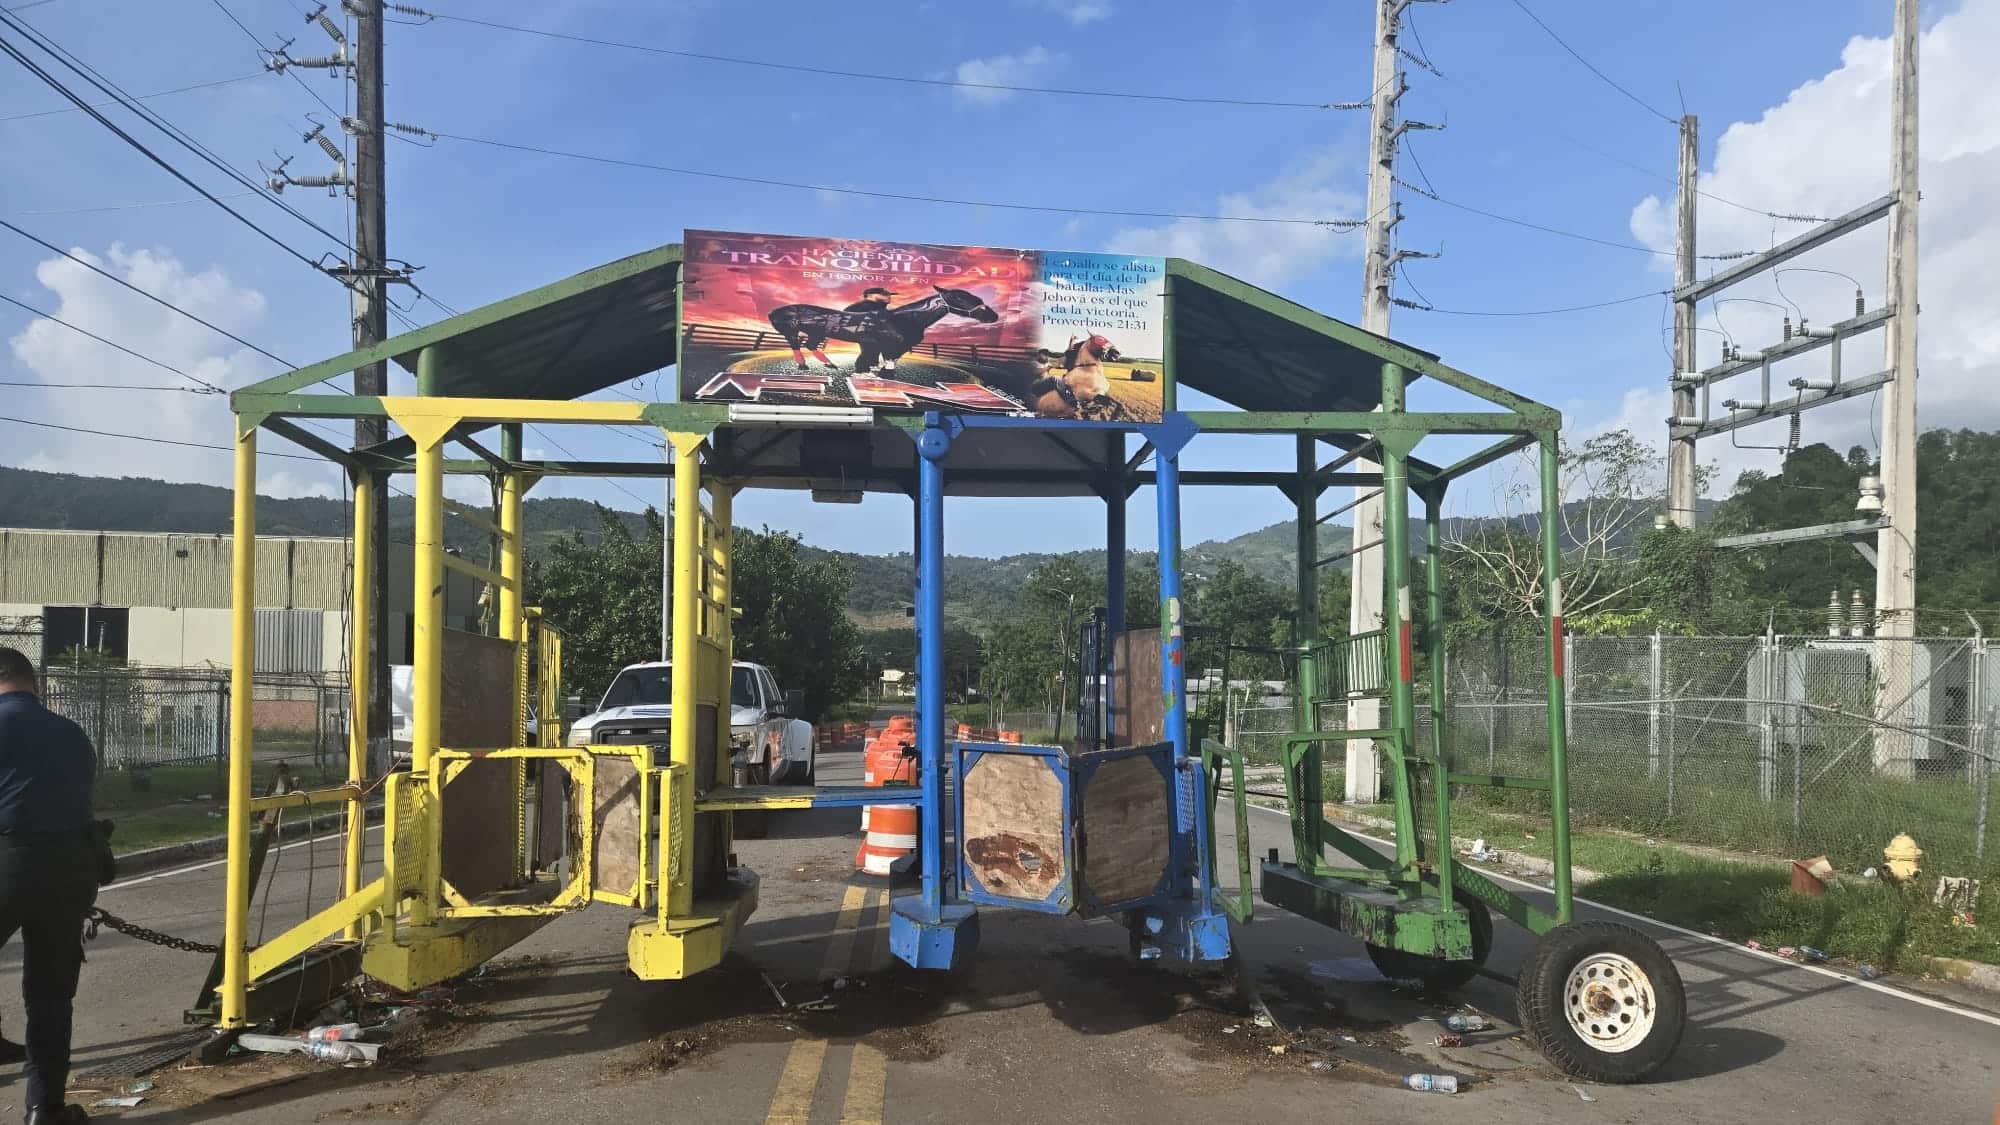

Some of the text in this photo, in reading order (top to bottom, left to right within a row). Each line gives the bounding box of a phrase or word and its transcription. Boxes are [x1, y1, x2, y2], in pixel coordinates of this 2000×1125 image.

[801, 247, 931, 263] HACIENDA
[721, 251, 1018, 278] TRANQUILIDAD
[1122, 261, 1156, 273] alista
[829, 272, 885, 282] HONOR
[1043, 271, 1073, 281] para
[1077, 271, 1089, 280] el
[1116, 273, 1133, 283] de
[1136, 274, 1147, 284] la
[1055, 281, 1136, 295] batalla: Mas
[1042, 292, 1087, 304] Jehová
[1108, 296, 1120, 306] el
[1124, 299, 1148, 310] que
[1050, 304, 1139, 319] da la victoria.
[1042, 315, 1147, 330] Proverbios 21:31
